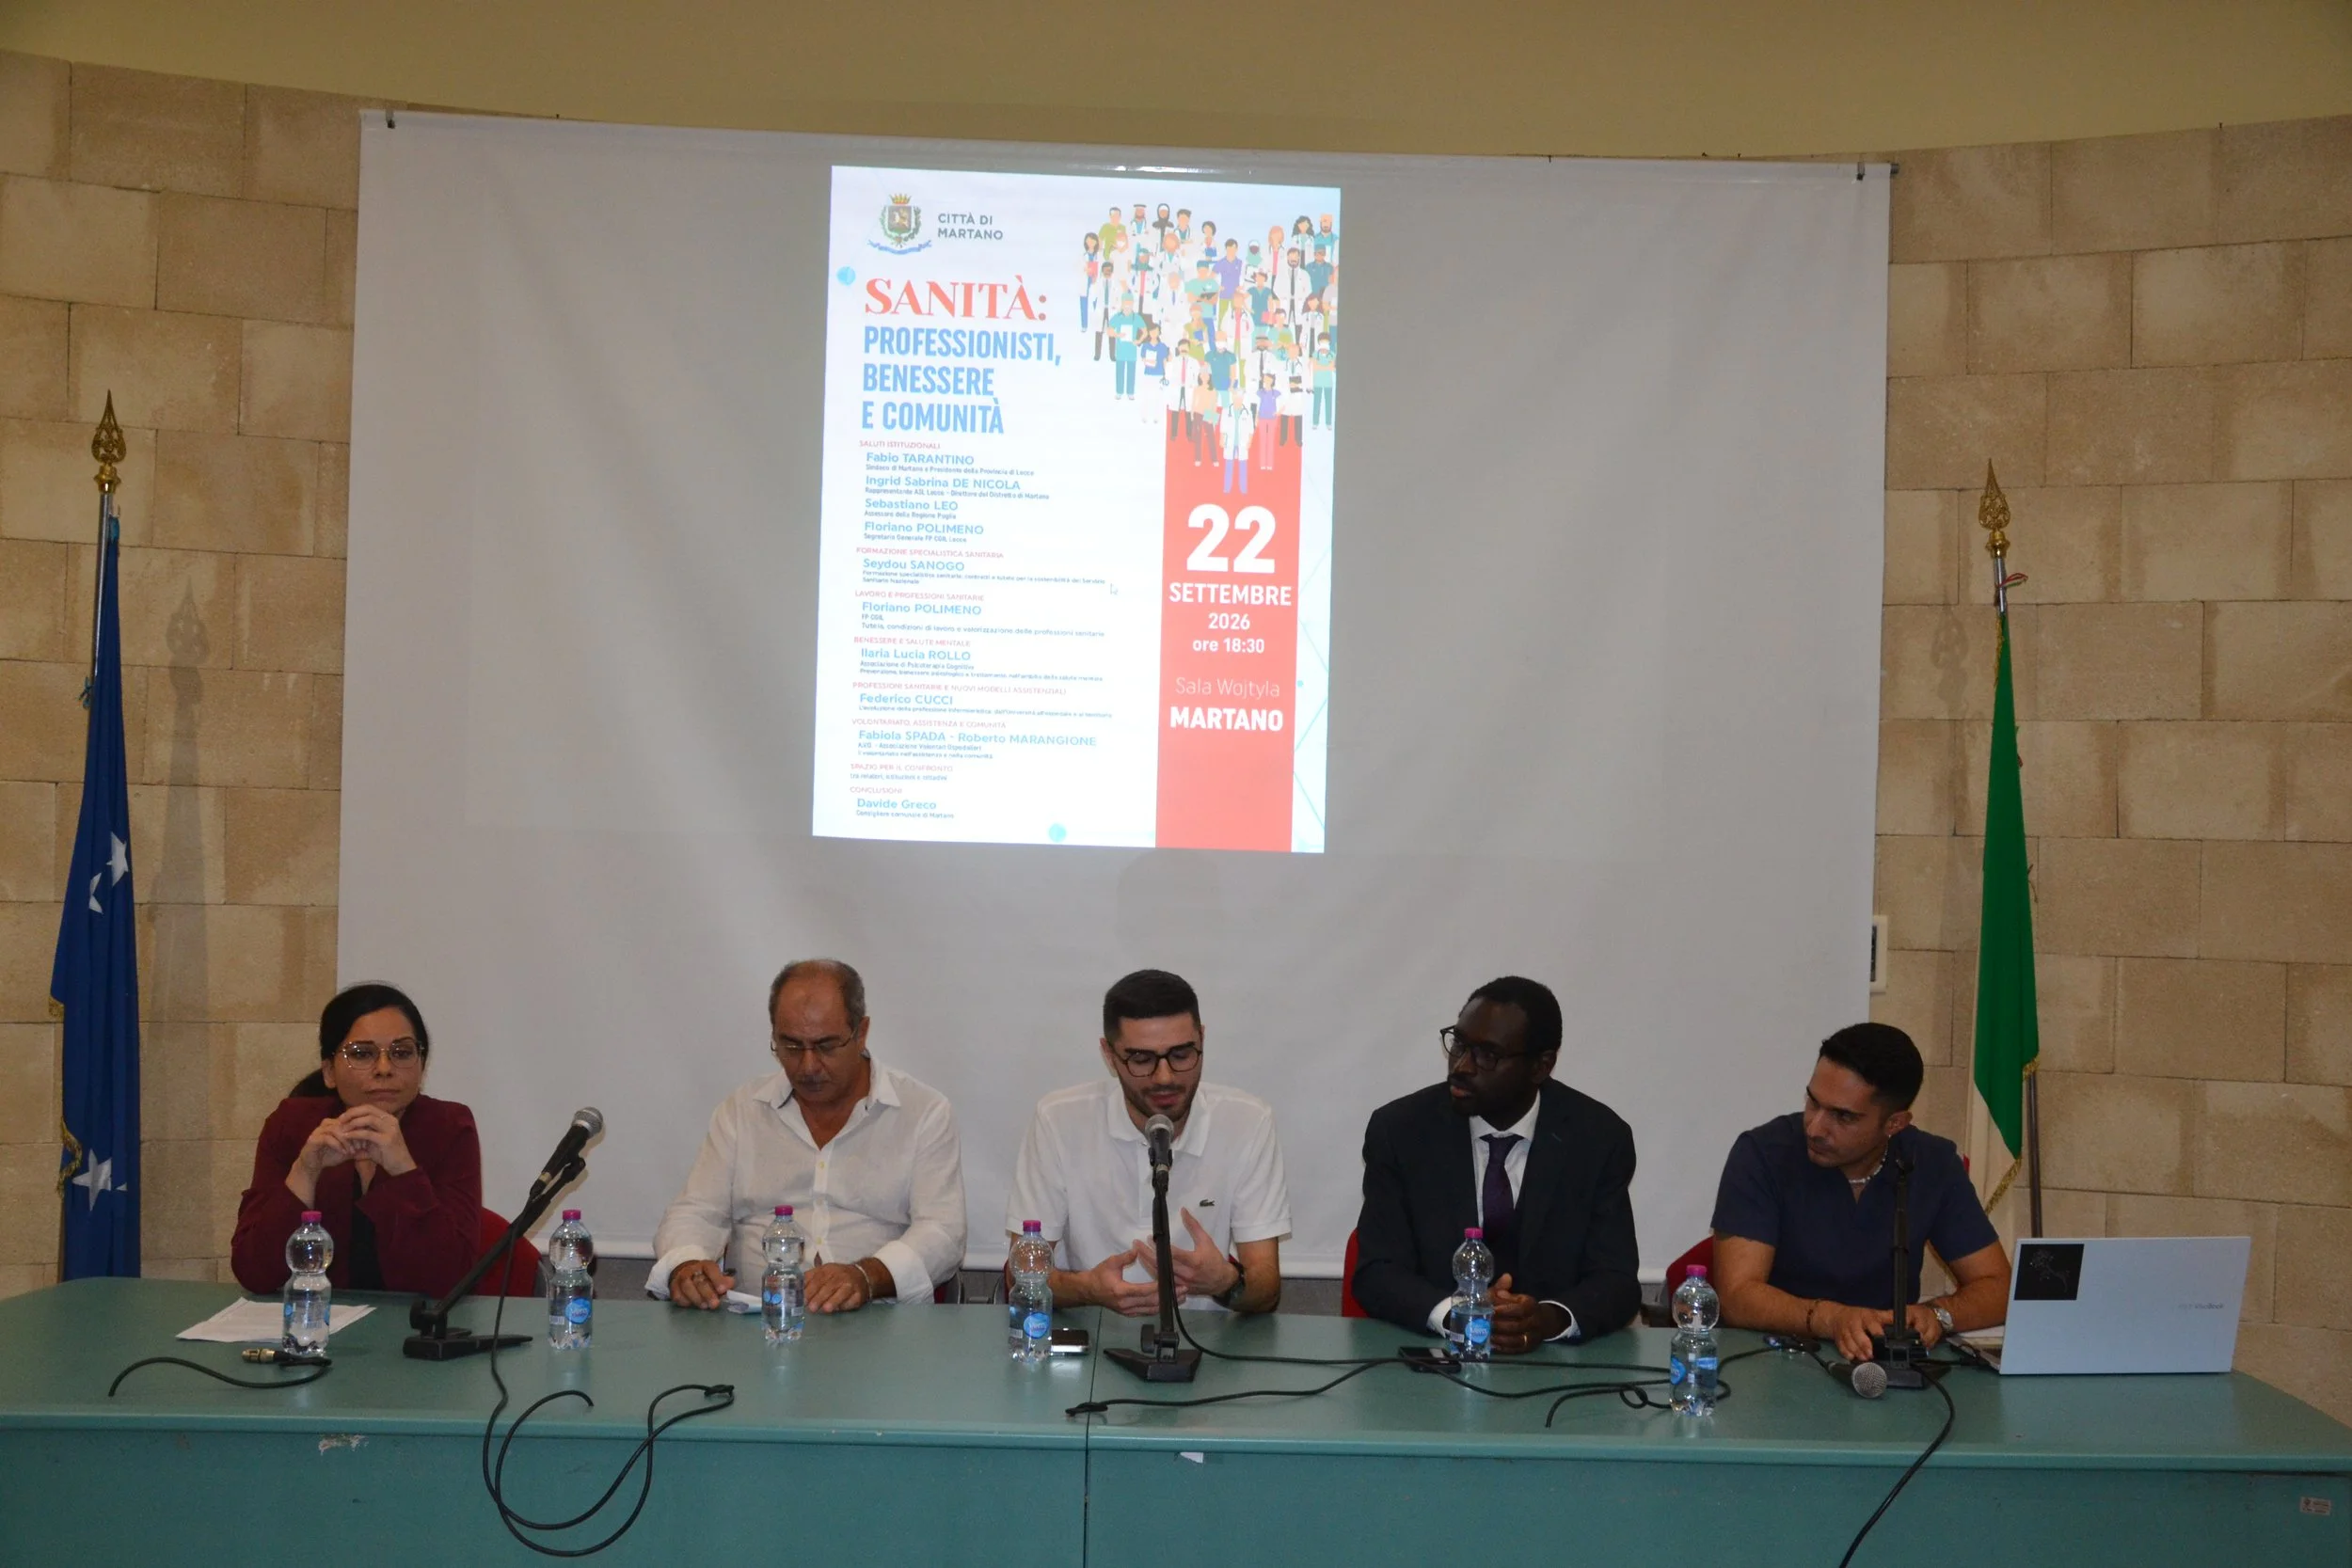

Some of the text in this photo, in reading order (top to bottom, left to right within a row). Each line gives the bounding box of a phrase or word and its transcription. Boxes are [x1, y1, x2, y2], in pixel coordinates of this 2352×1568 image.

[938, 213, 992, 225] CITTÀ DI
[938, 228, 1003, 240] MARTANO
[866, 275, 1047, 321] SANITÀ:
[865, 326, 1060, 367] PROFESSIONISTI,
[863, 364, 994, 396] BENESSERE
[862, 396, 1004, 434] E COMUNITÀ
[887, 441, 940, 450] ISTITUZIONALI
[866, 452, 974, 465] Fabio TARANTINO
[866, 475, 1021, 490] Ingrid Sabrina DE NICOLA
[866, 499, 958, 511] Sebastiano LEO
[865, 522, 983, 534] Floriano POLIMENO
[1187, 503, 1276, 573] 22
[864, 559, 964, 571] Seydou SANOGO
[1168, 582, 1291, 606] SETTEMBRE
[863, 602, 981, 615] Floriano POLIMENO
[1208, 612, 1250, 629] 2026
[1193, 638, 1264, 653] ore 18:30
[862, 648, 971, 660] Ilaria Lucia ROLLO
[1176, 676, 1279, 700] Sala Wojtyla
[860, 693, 953, 705] Federico CUCCI
[1170, 706, 1283, 731] MARTANO
[859, 730, 901, 740] Fabiola
[905, 731, 946, 741] SPADA
[959, 733, 1006, 743] Roberto
[1009, 734, 1097, 746] MARANGIONE
[857, 799, 936, 810] Davide Greco
